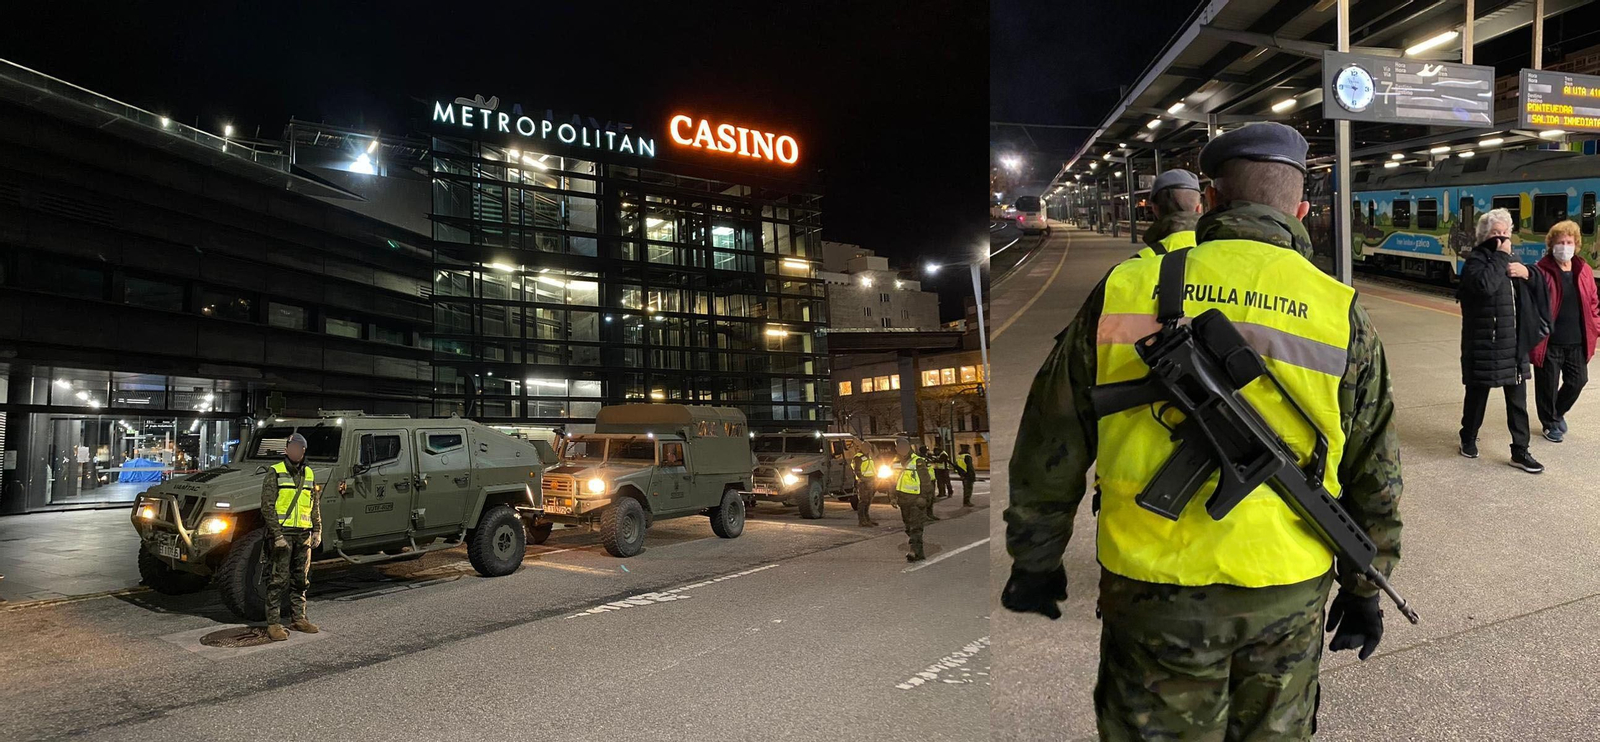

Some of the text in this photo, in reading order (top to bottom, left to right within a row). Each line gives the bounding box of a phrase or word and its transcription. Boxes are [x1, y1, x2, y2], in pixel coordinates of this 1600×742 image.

[1380, 81, 1393, 104] 7
[1527, 103, 1574, 115] PONTEVEDRA
[1531, 114, 1560, 125] SALIDA
[432, 100, 656, 157] METROPOLITAN
[669, 113, 800, 165] CASINO
[1152, 284, 1309, 320] PRULLA MILITAR
